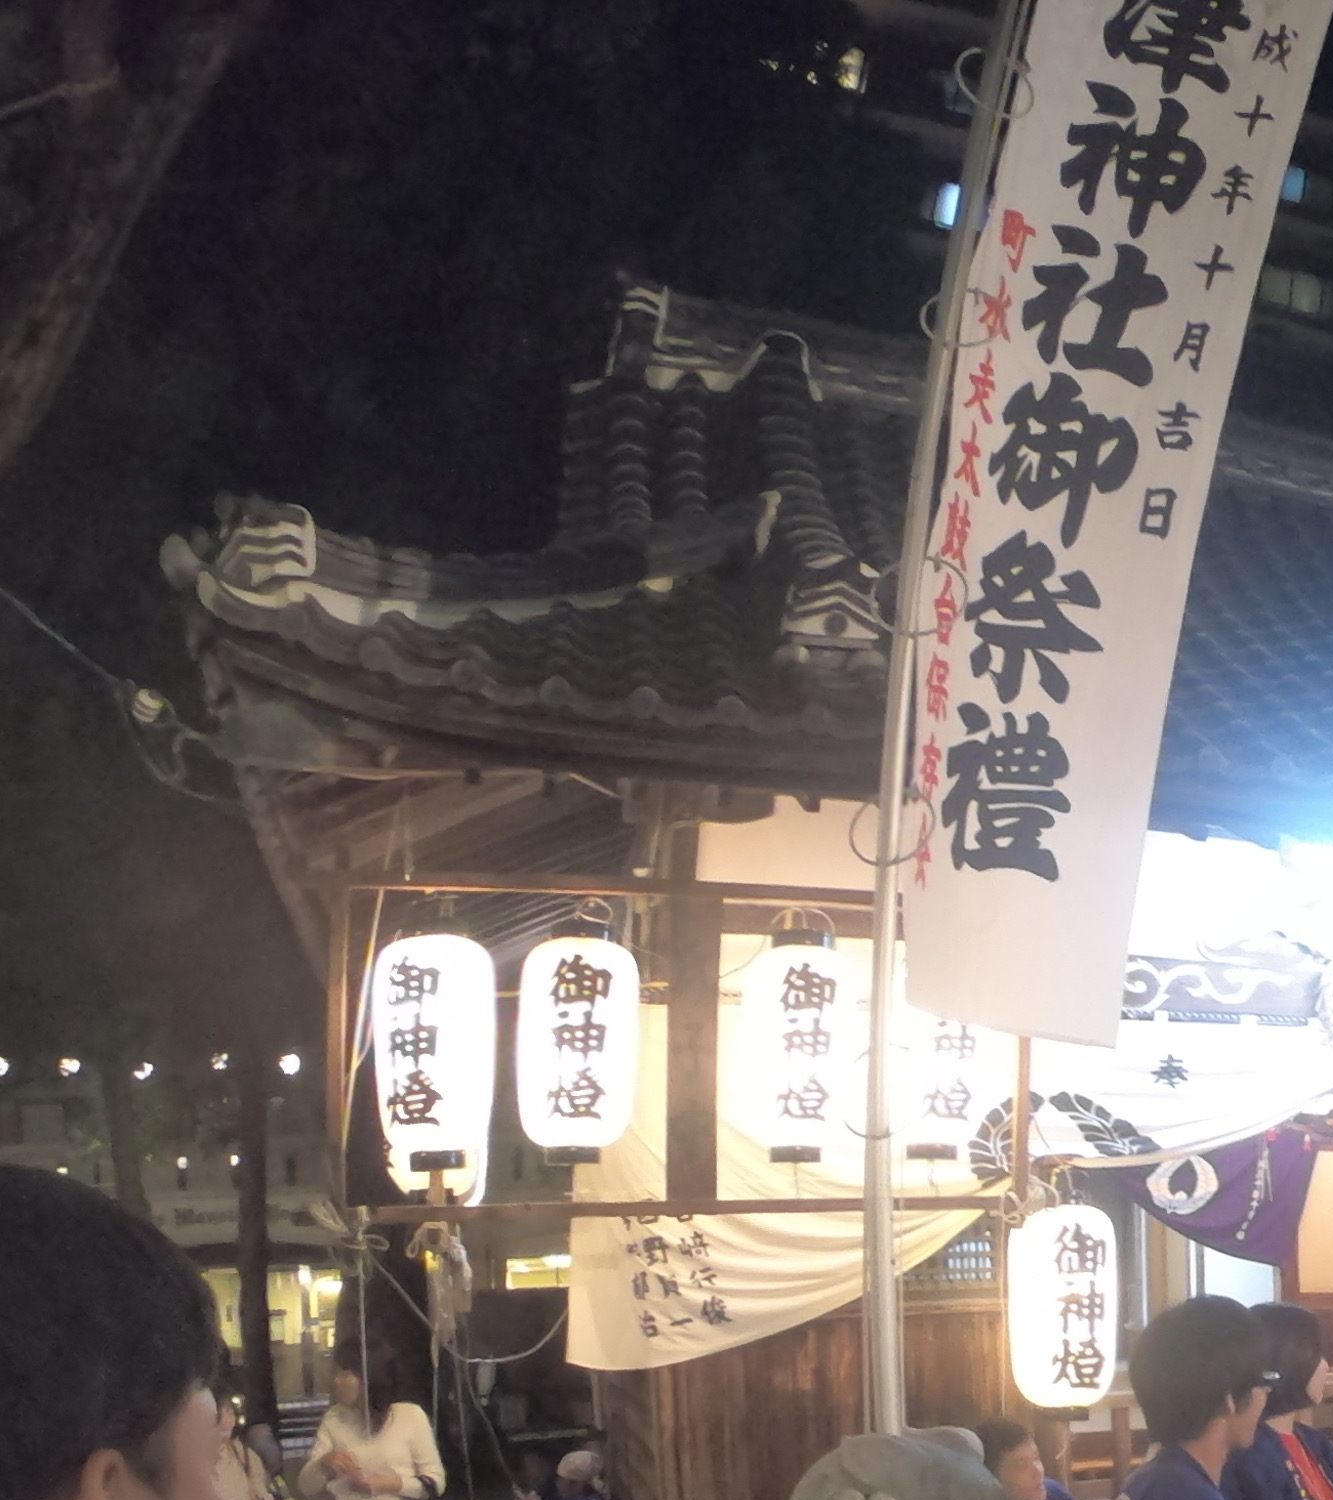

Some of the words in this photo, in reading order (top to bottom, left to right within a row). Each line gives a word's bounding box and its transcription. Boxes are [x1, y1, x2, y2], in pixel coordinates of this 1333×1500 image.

[1139, 23, 1299, 540] 成十年十月吉日
[1052, 1223, 1107, 1389] 御神燈
